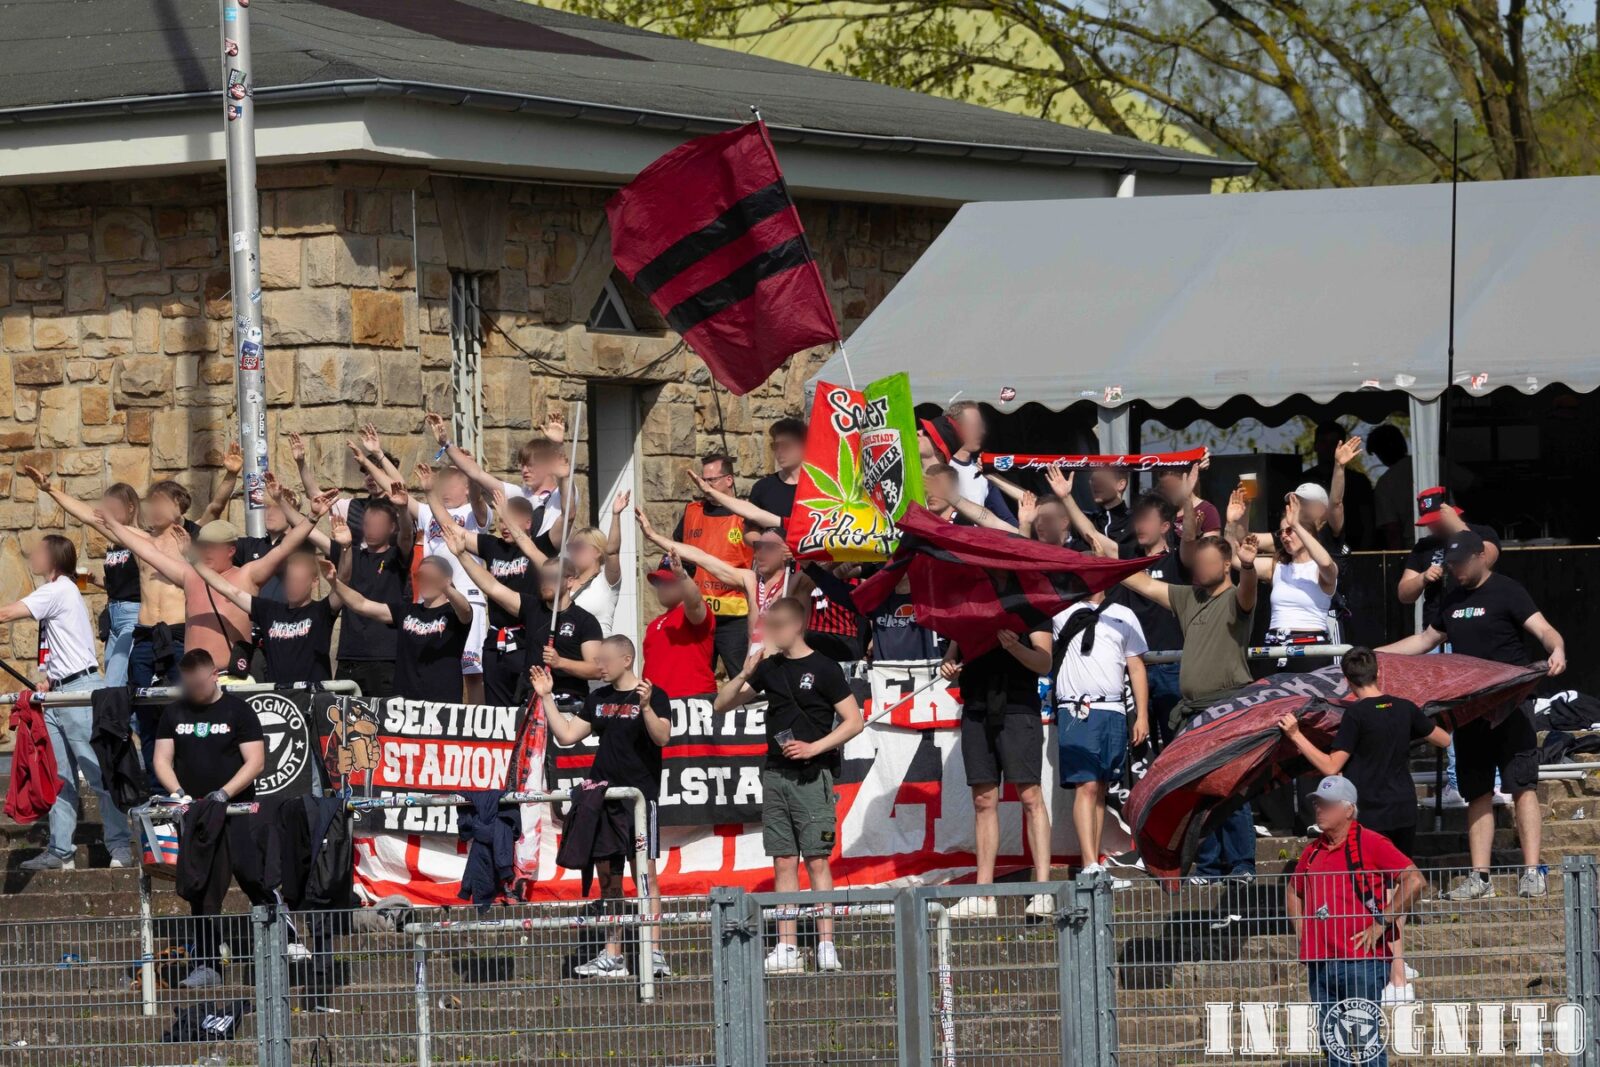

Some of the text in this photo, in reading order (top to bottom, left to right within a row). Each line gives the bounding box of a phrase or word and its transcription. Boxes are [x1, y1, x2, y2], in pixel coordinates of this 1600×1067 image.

[1133, 455, 1190, 472] Donau
[384, 697, 519, 740] SEKTION
[382, 742, 514, 791] STADION
